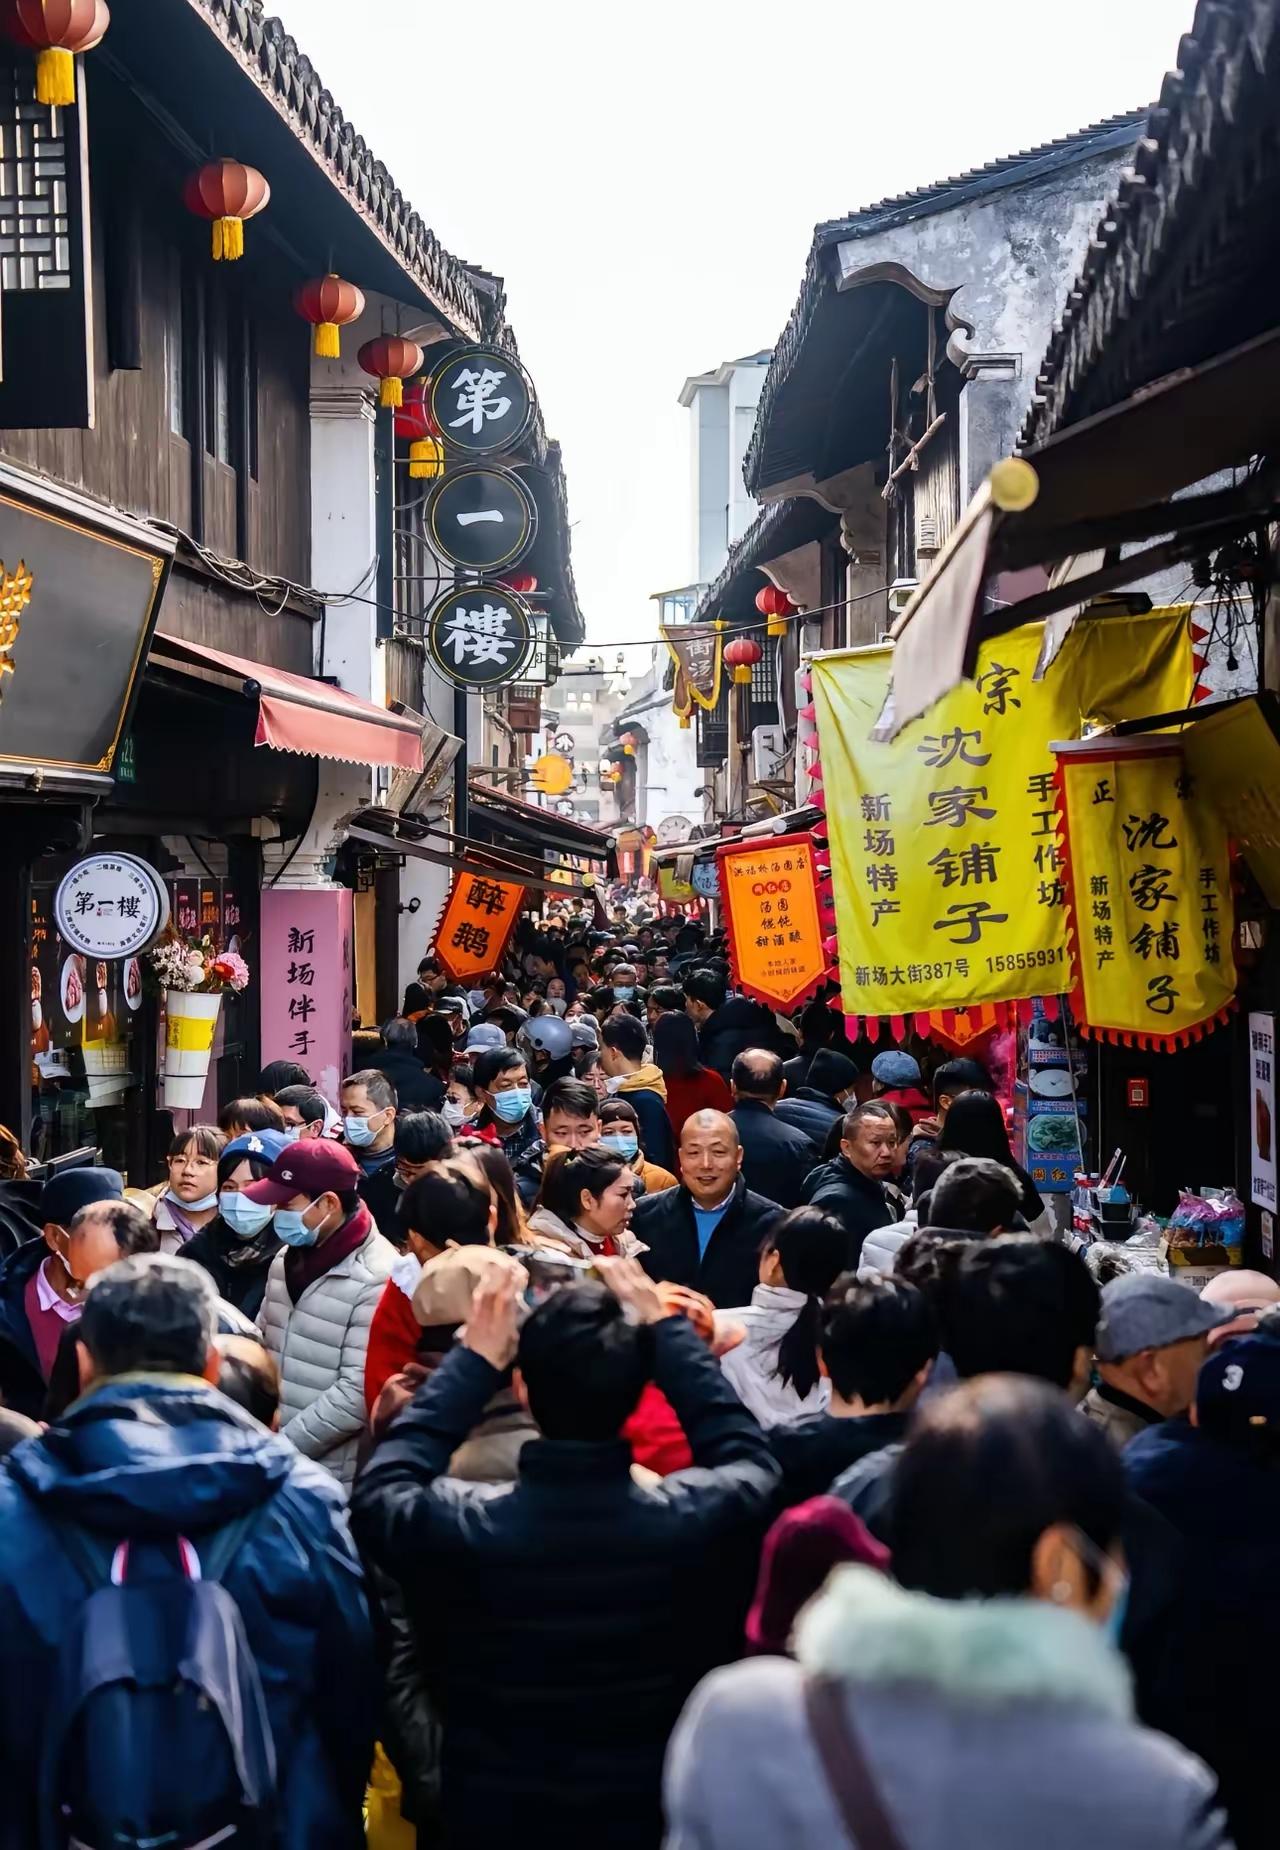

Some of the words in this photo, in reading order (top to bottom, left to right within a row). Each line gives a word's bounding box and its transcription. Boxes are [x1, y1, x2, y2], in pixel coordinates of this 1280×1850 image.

[444, 368, 515, 665] 第一樓
[860, 794, 900, 927] 新场特产
[917, 726, 1008, 944] 沈家铺子
[1026, 772, 1067, 906] 手工作坊
[74, 891, 141, 919] 第一樓
[452, 878, 509, 958] 醉鹅
[755, 930, 802, 947] 甜酒酿
[760, 898, 789, 913] 汤圆
[1090, 875, 1114, 970] 新场特产
[1122, 813, 1180, 1015] 沈家铺子
[1200, 867, 1220, 964] 手工作坊
[287, 927, 317, 1087] 新场伴手
[855, 957, 970, 987] 新场大街387号
